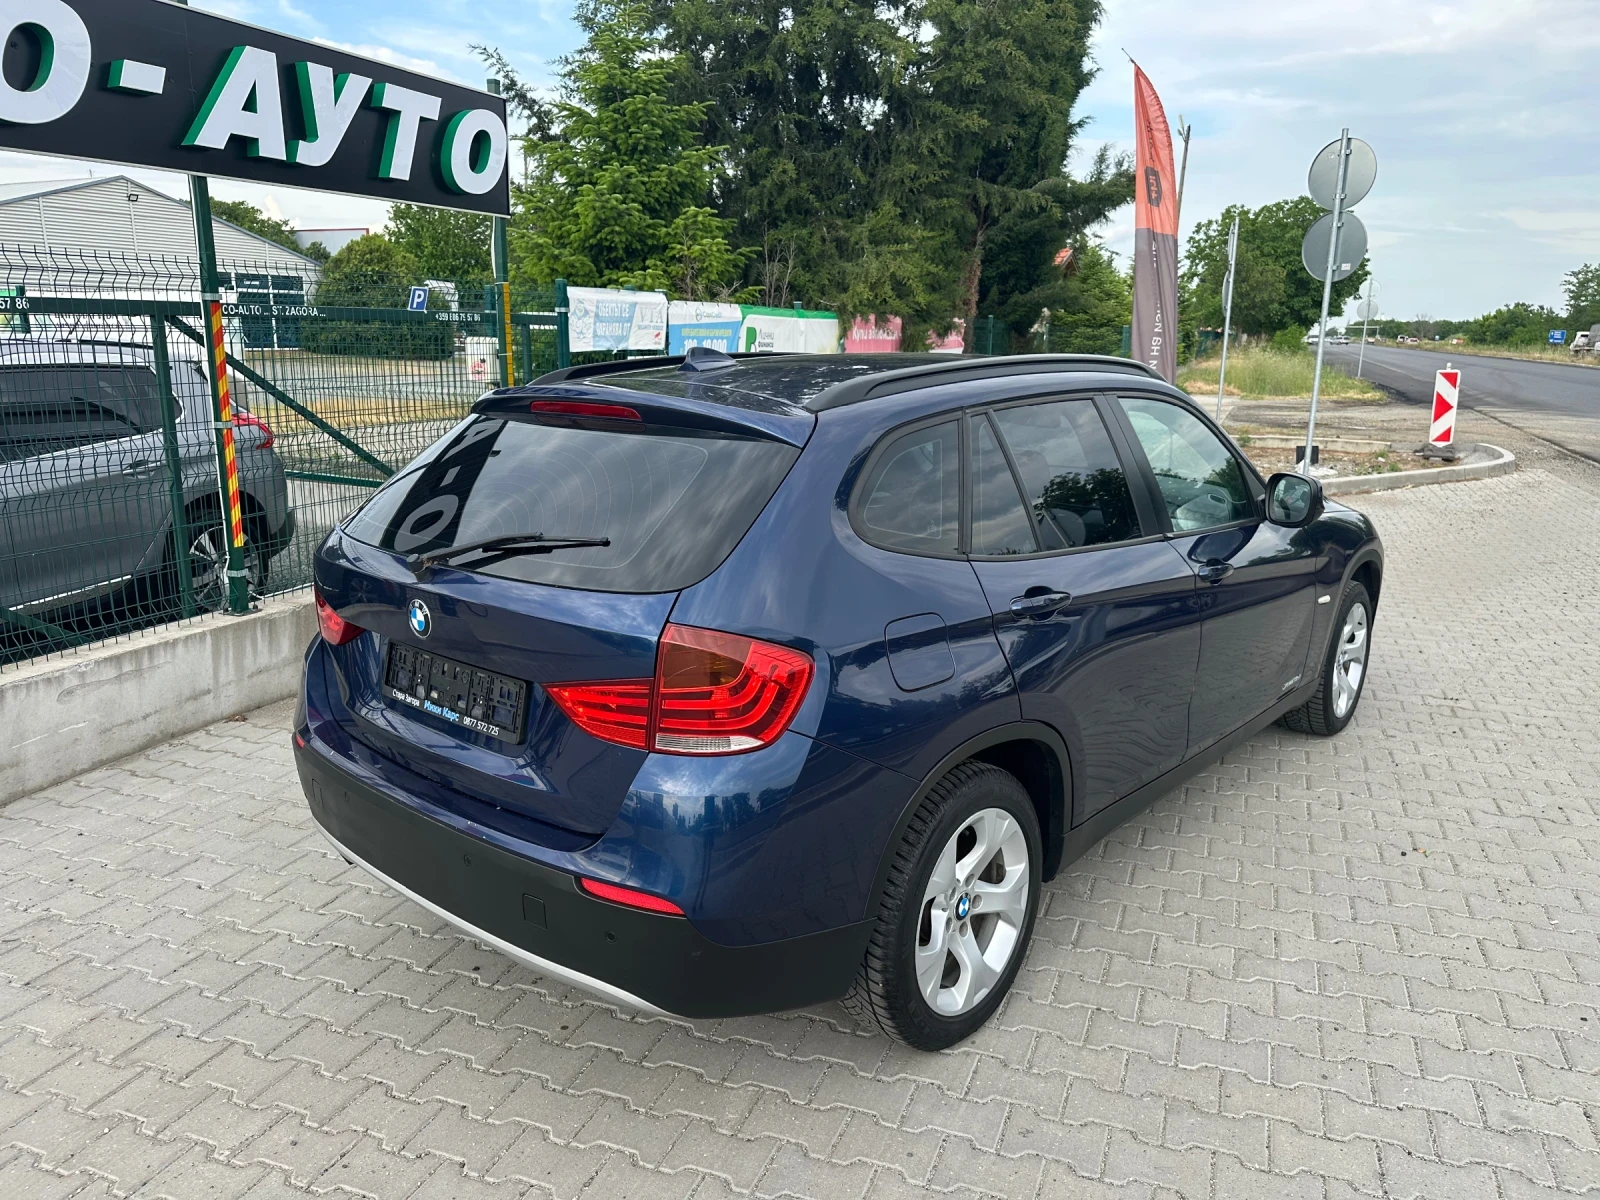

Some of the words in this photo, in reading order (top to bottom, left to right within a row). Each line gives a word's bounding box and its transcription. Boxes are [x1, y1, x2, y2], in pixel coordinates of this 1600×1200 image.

[0, 297, 11, 310] 57
[15, 297, 30, 310] 86
[412, 289, 425, 309] P
[392, 688, 405, 701] Стара
[405, 693, 420, 707] Загора
[442, 706, 460, 722] Карс
[463, 716, 477, 728] 0877
[477, 721, 488, 732] 572
[488, 724, 500, 736] 725
